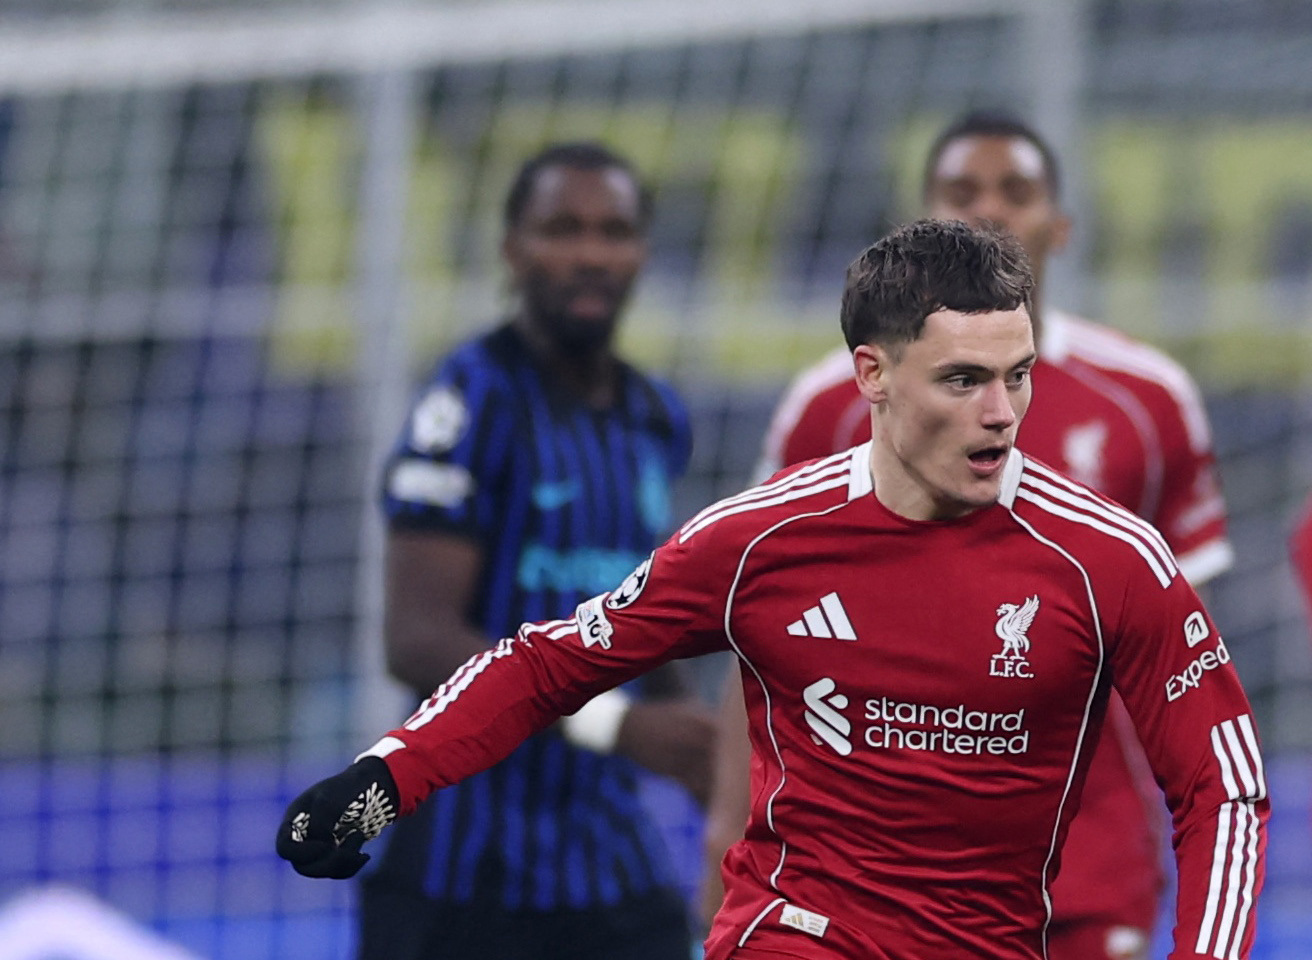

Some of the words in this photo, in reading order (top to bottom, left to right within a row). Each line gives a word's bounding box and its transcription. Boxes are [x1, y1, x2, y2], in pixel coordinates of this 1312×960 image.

[1165, 636, 1231, 702] Exped
[864, 696, 1025, 732] standard
[864, 722, 1029, 755] chartered
